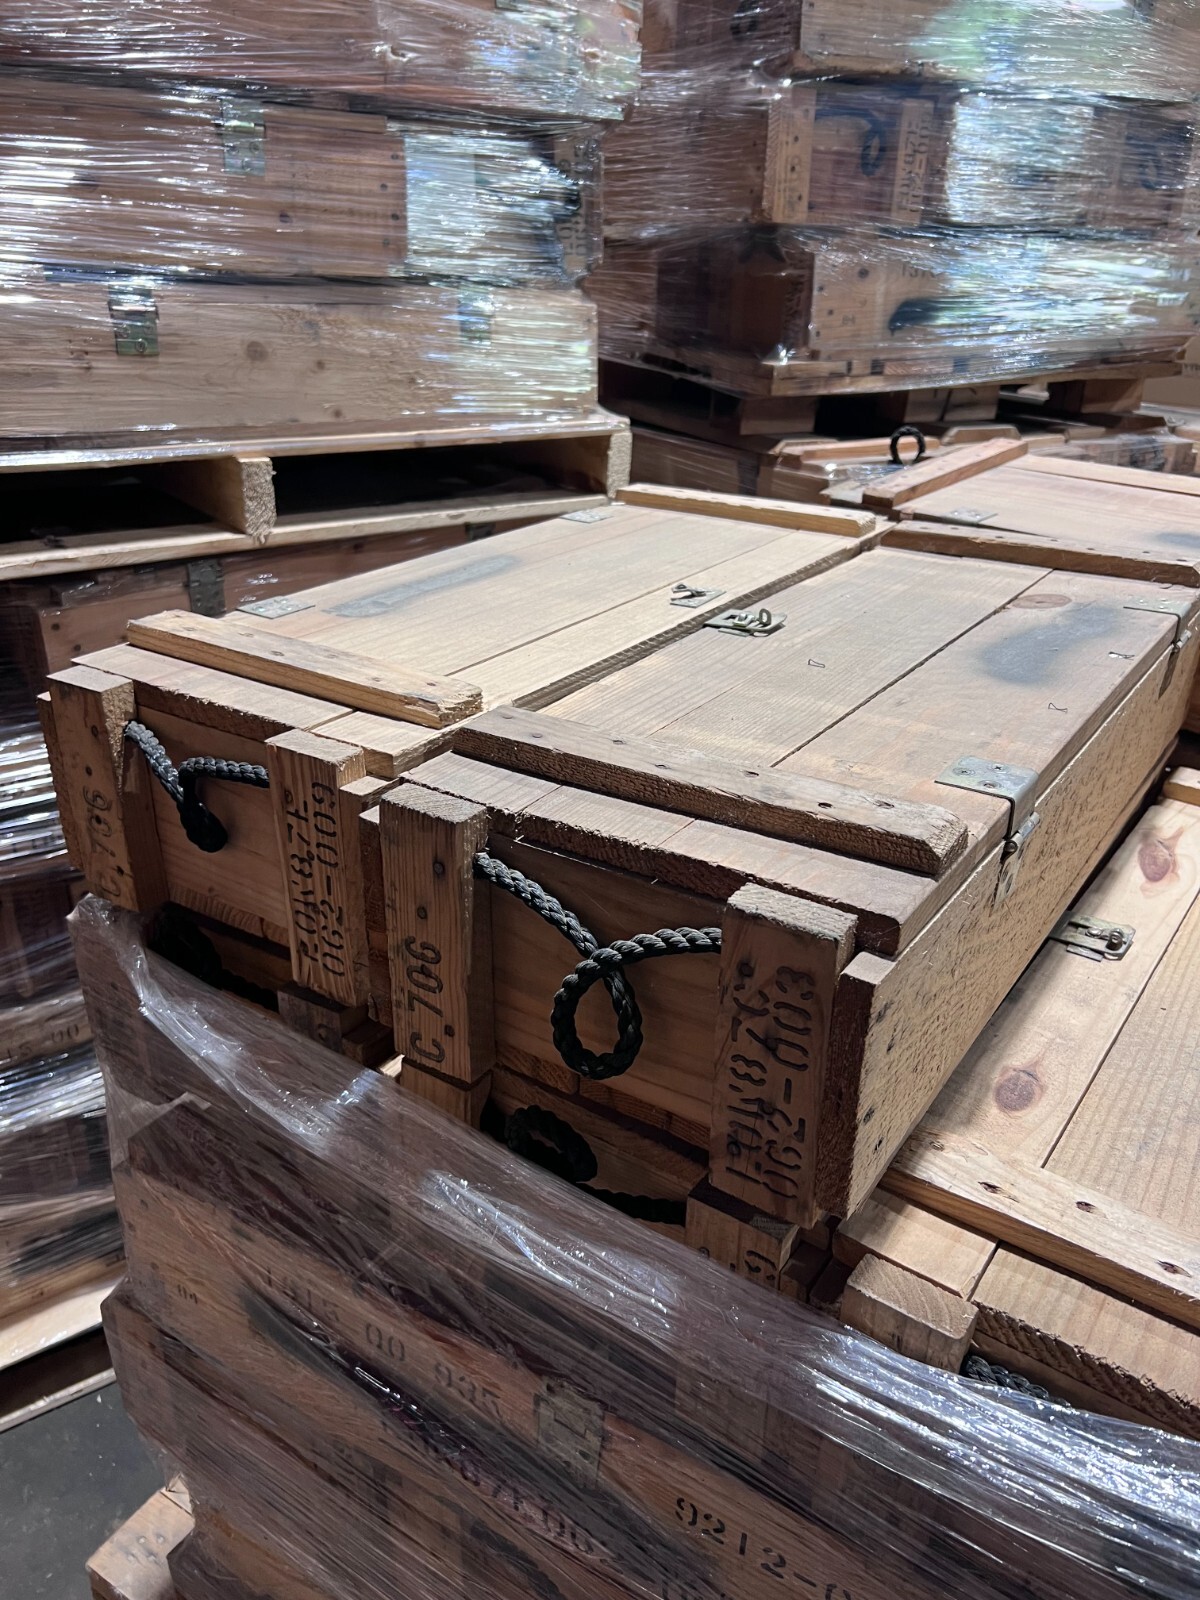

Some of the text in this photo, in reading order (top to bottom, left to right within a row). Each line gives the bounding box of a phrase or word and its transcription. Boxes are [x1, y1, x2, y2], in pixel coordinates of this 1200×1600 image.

[83, 785, 116, 858] 706
[311, 780, 346, 977] 062-009
[404, 935, 446, 1064] C 706
[762, 965, 815, 1198] 062-003
[366, 1323, 406, 1362] 00
